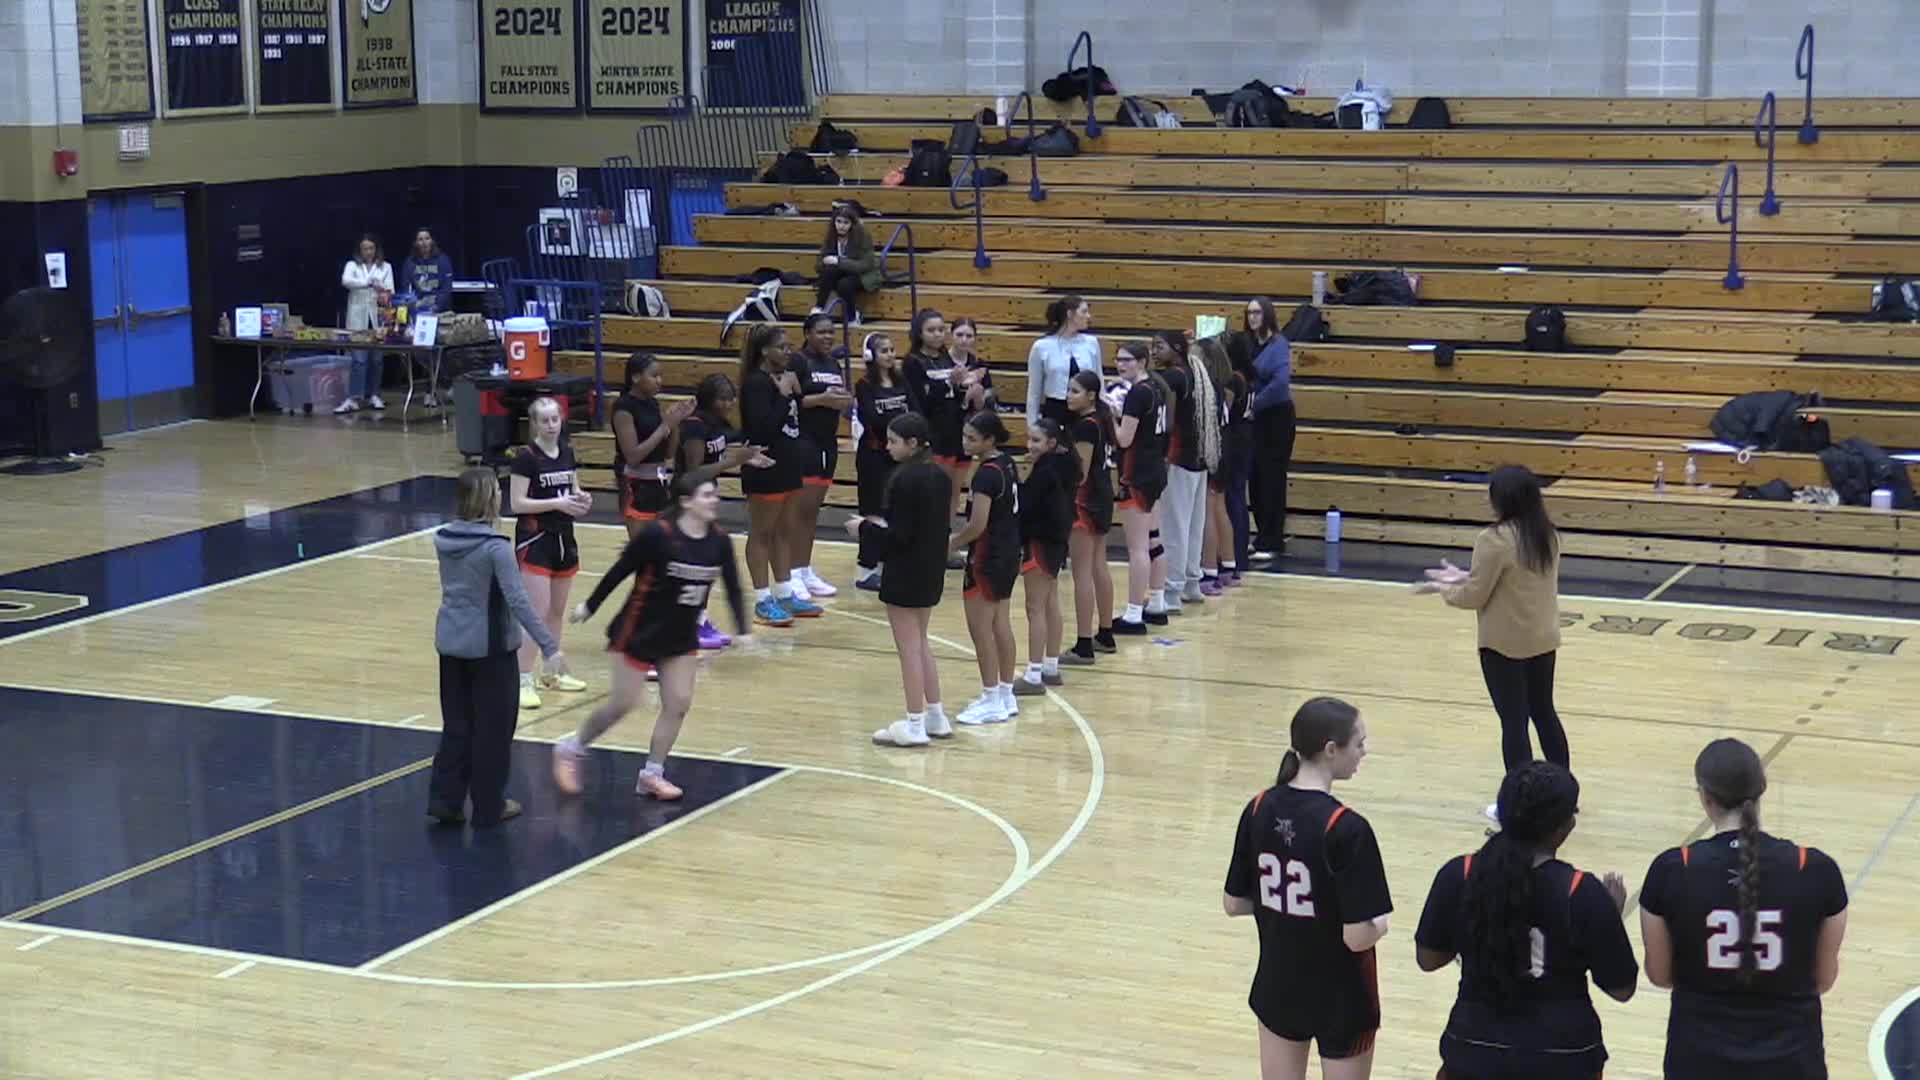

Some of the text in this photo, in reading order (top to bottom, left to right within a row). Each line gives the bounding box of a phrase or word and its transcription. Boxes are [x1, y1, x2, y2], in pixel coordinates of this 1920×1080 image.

[726, 2, 781, 17] LEAGUE
[169, 12, 239, 29] CHAMPIONS
[261, 13, 328, 28] CHAMPIONS
[495, 8, 561, 35] 2024
[602, 7, 669, 35] 2024
[501, 65, 559, 76] FALL STATE
[601, 66, 674, 77] WINTER STATE
[490, 81, 570, 95] CHAMPIONS
[596, 82, 679, 96] CHAMPIONS
[511, 341, 525, 360] G
[1257, 852, 1316, 918] 22
[1706, 909, 1783, 971] 25
[1528, 926, 1545, 979] 1
